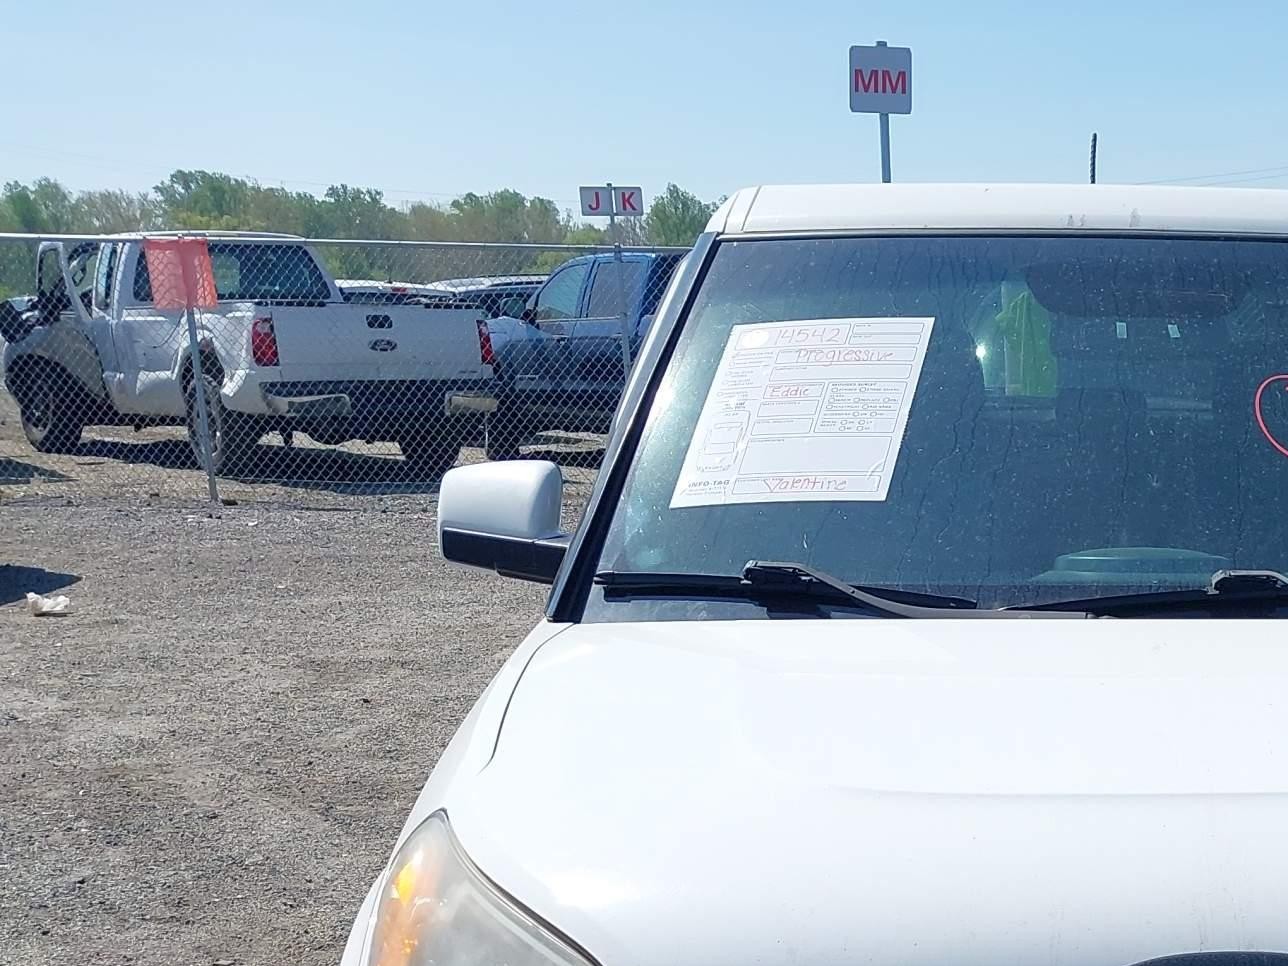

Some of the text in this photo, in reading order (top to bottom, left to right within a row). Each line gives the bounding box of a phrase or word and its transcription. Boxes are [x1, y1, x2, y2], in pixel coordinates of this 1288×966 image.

[854, 68, 907, 95] MM
[588, 191, 637, 211] J K
